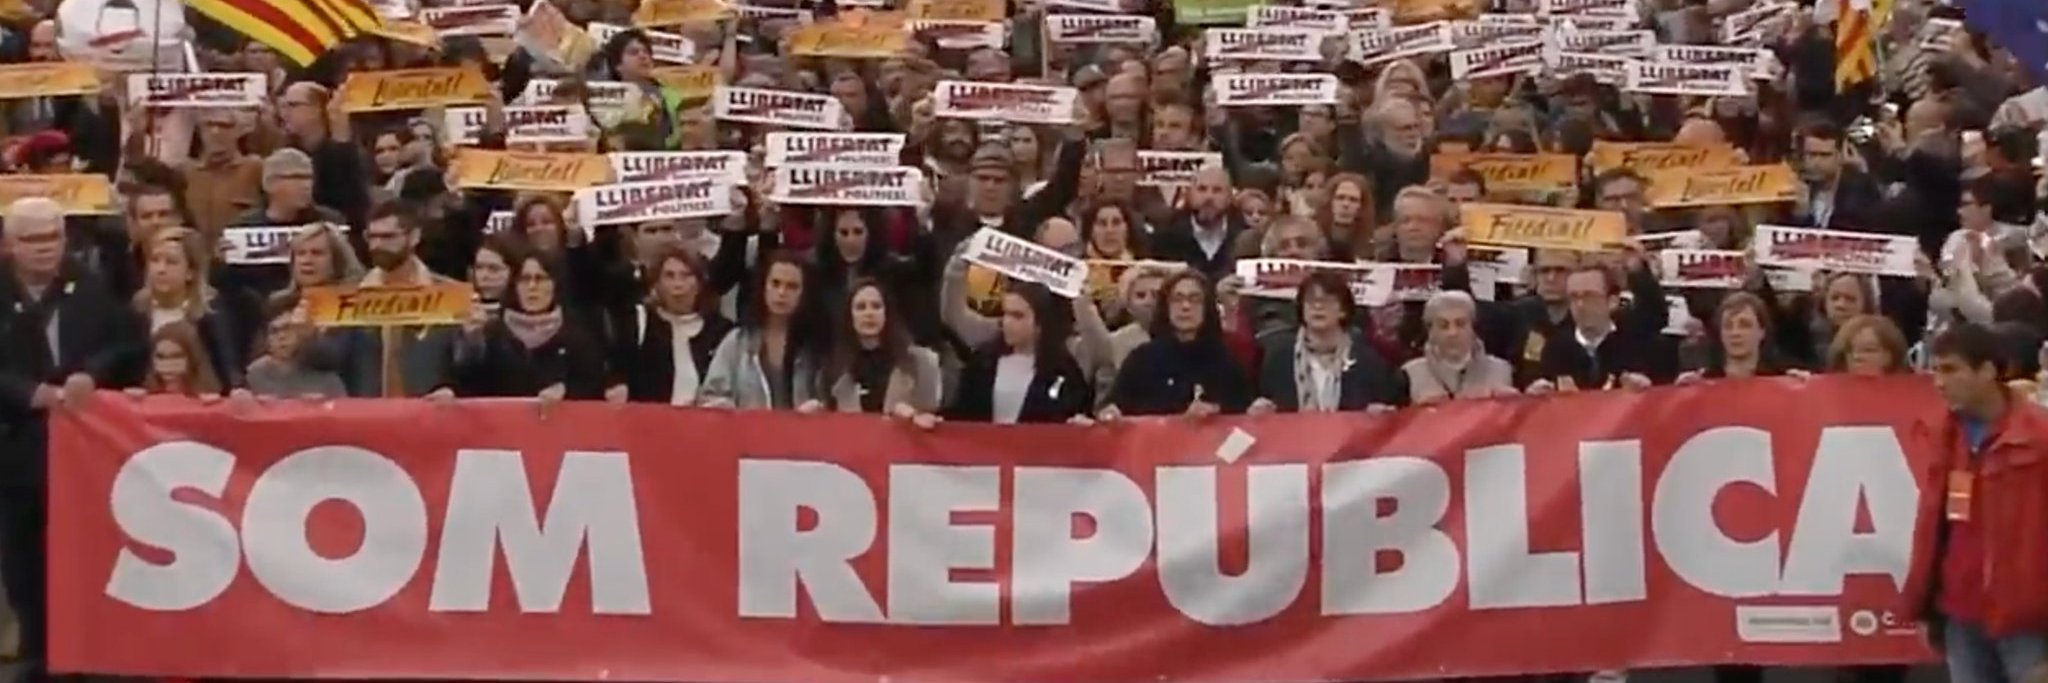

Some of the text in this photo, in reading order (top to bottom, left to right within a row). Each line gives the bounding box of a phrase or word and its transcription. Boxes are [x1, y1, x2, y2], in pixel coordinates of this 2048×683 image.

[1640, 66, 1731, 82] LLIBERTAT
[729, 91, 828, 112] LLIBERTAT
[786, 137, 891, 153] LLIBERTAT
[622, 155, 729, 173] LLIBERTAT
[789, 168, 908, 187] LLIBERTAT
[594, 181, 712, 206] LLIBERTAT
[985, 234, 1075, 278] LLIBERTAT
[105, 426, 1921, 626] SOM REPÚBLICA
